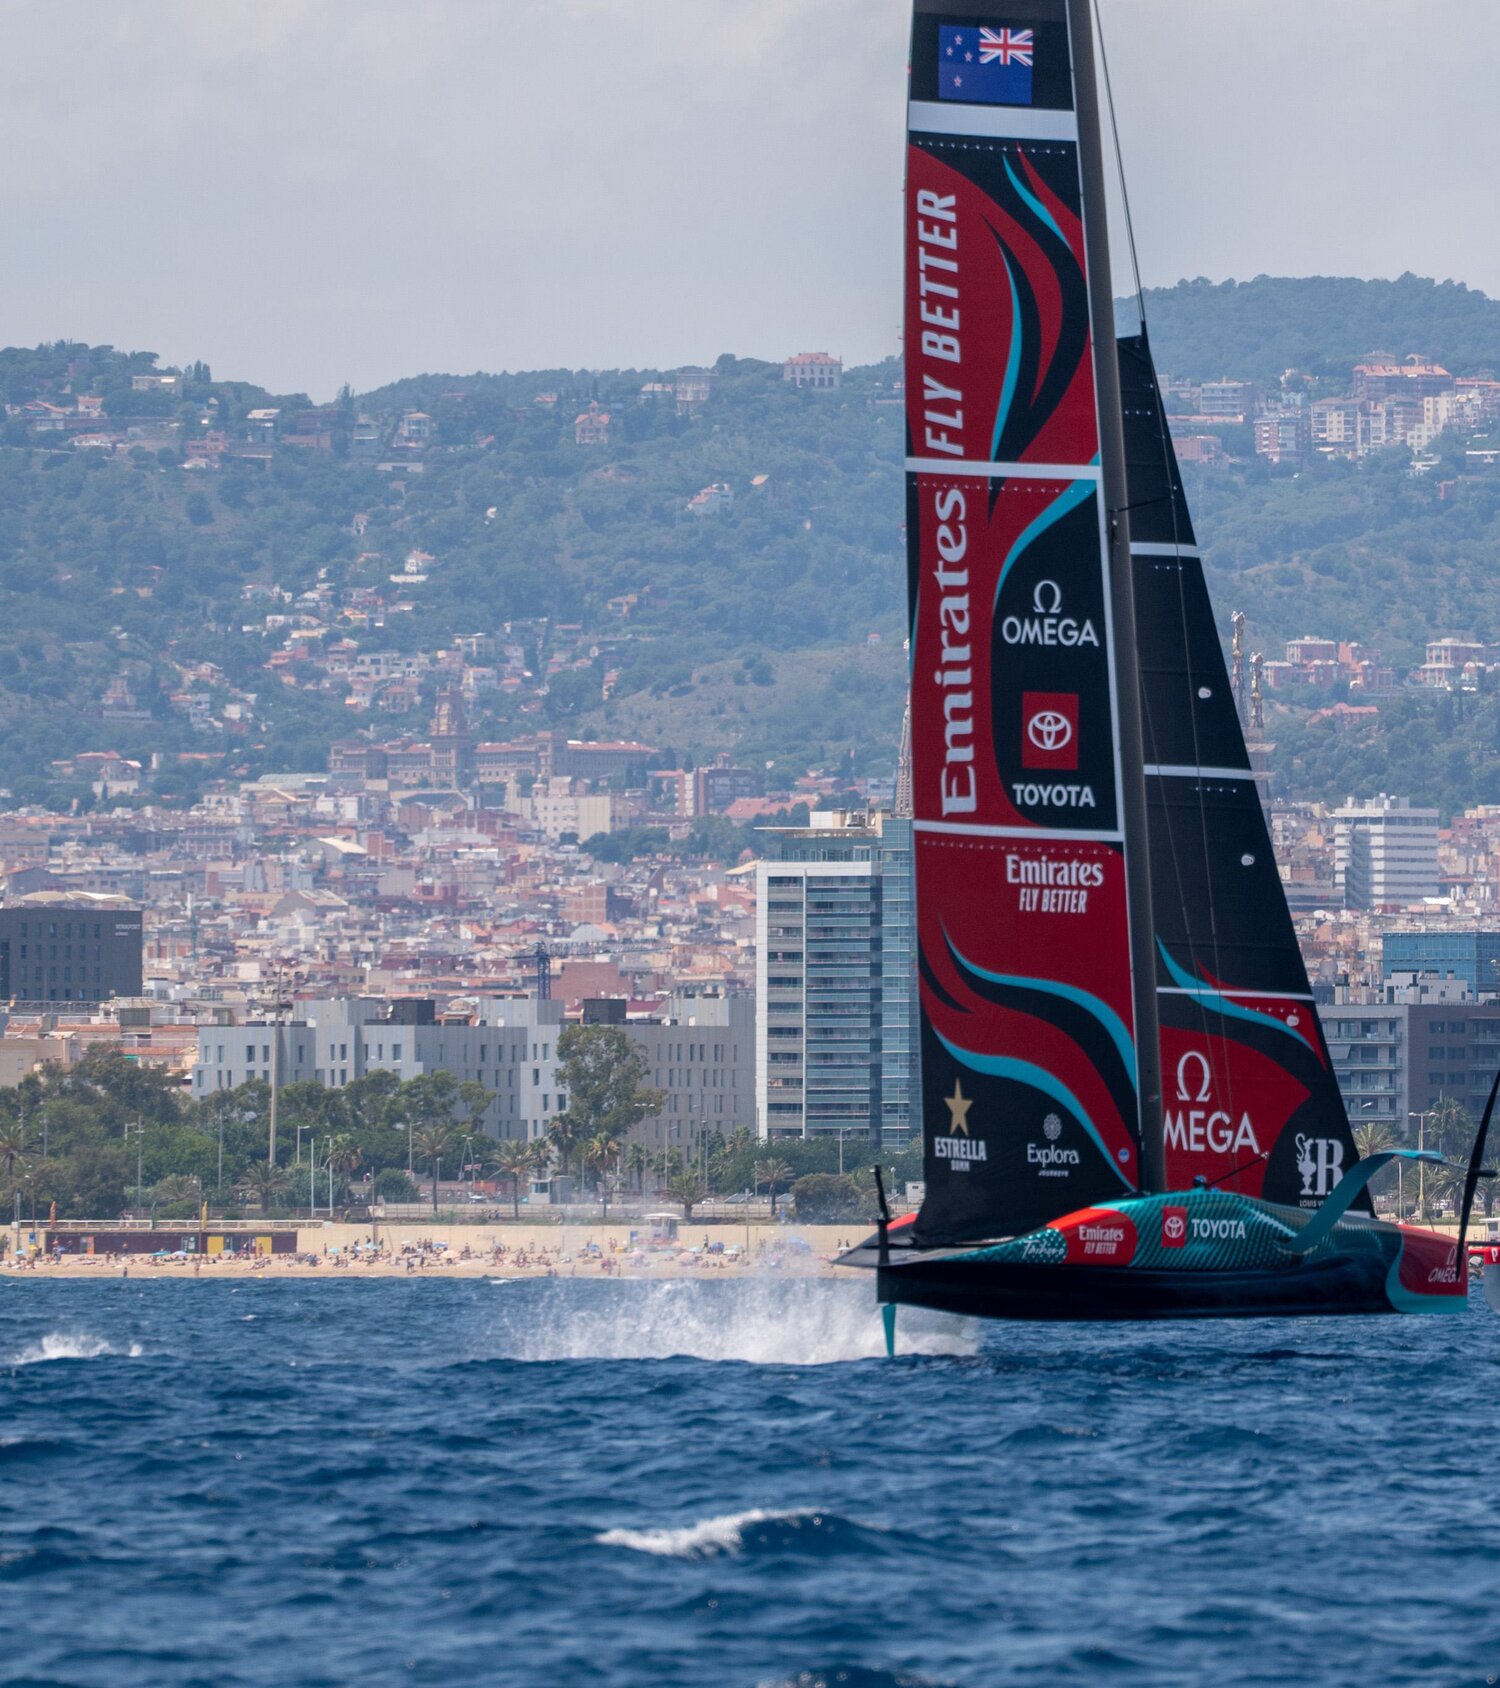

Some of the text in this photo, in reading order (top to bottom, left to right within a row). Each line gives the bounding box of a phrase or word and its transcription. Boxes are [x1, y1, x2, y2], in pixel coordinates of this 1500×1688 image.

[917, 189, 964, 457] FLY BETTER
[1002, 617, 1099, 647] OMEGA
[934, 488, 978, 817] Emirates
[1012, 783, 1096, 808] TOYOTA
[1006, 854, 1104, 888] Emirates
[1019, 888, 1087, 915] FLY BETTER
[1163, 1109, 1260, 1154] MEGA
[934, 1136, 987, 1161] ESTRELLA
[1027, 1143, 1080, 1168] Explora
[1299, 1199, 1317, 1208] LOUIS
[1078, 1225, 1124, 1242] Emirates
[1191, 1218, 1246, 1240] TOYOTA
[1428, 1267, 1461, 1283] OMEG
